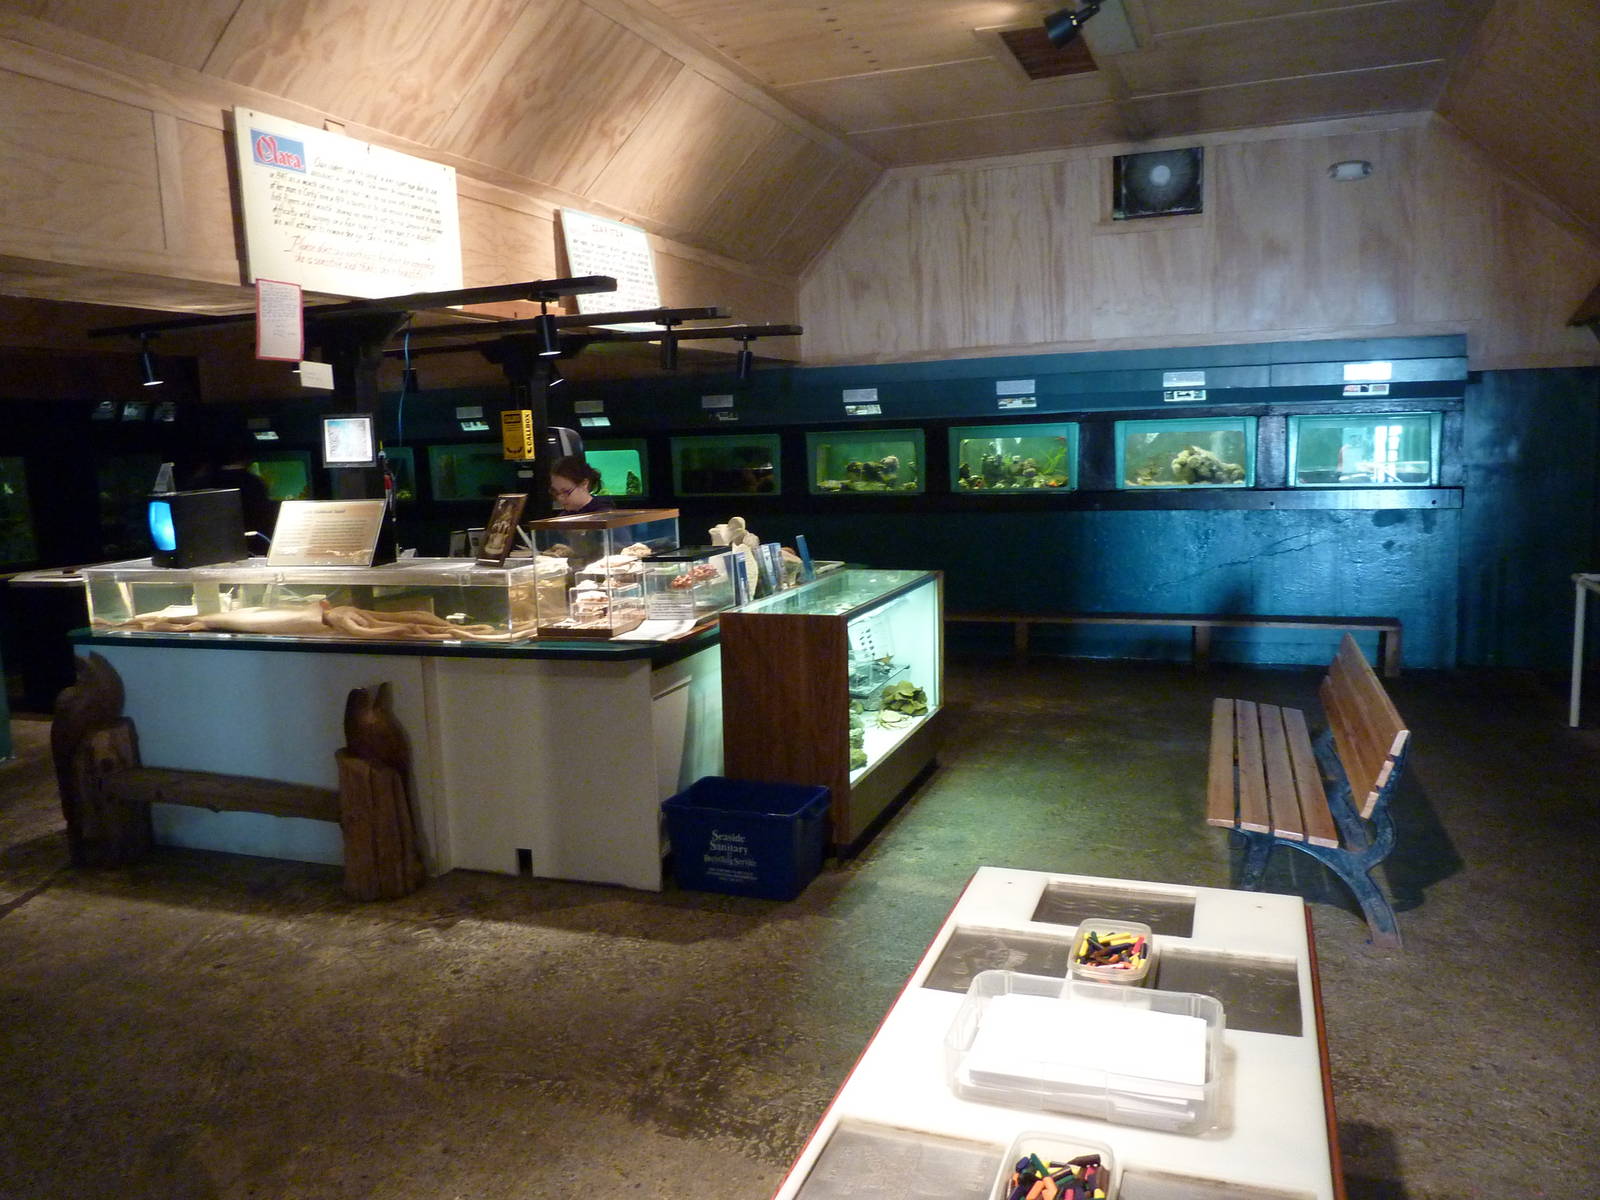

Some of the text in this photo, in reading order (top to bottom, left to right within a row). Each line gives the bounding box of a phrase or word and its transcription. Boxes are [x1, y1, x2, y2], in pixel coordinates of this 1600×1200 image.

[256, 135, 304, 169] Clara
[712, 829, 746, 843] Seaside
[710, 841, 748, 855] Sanitary
